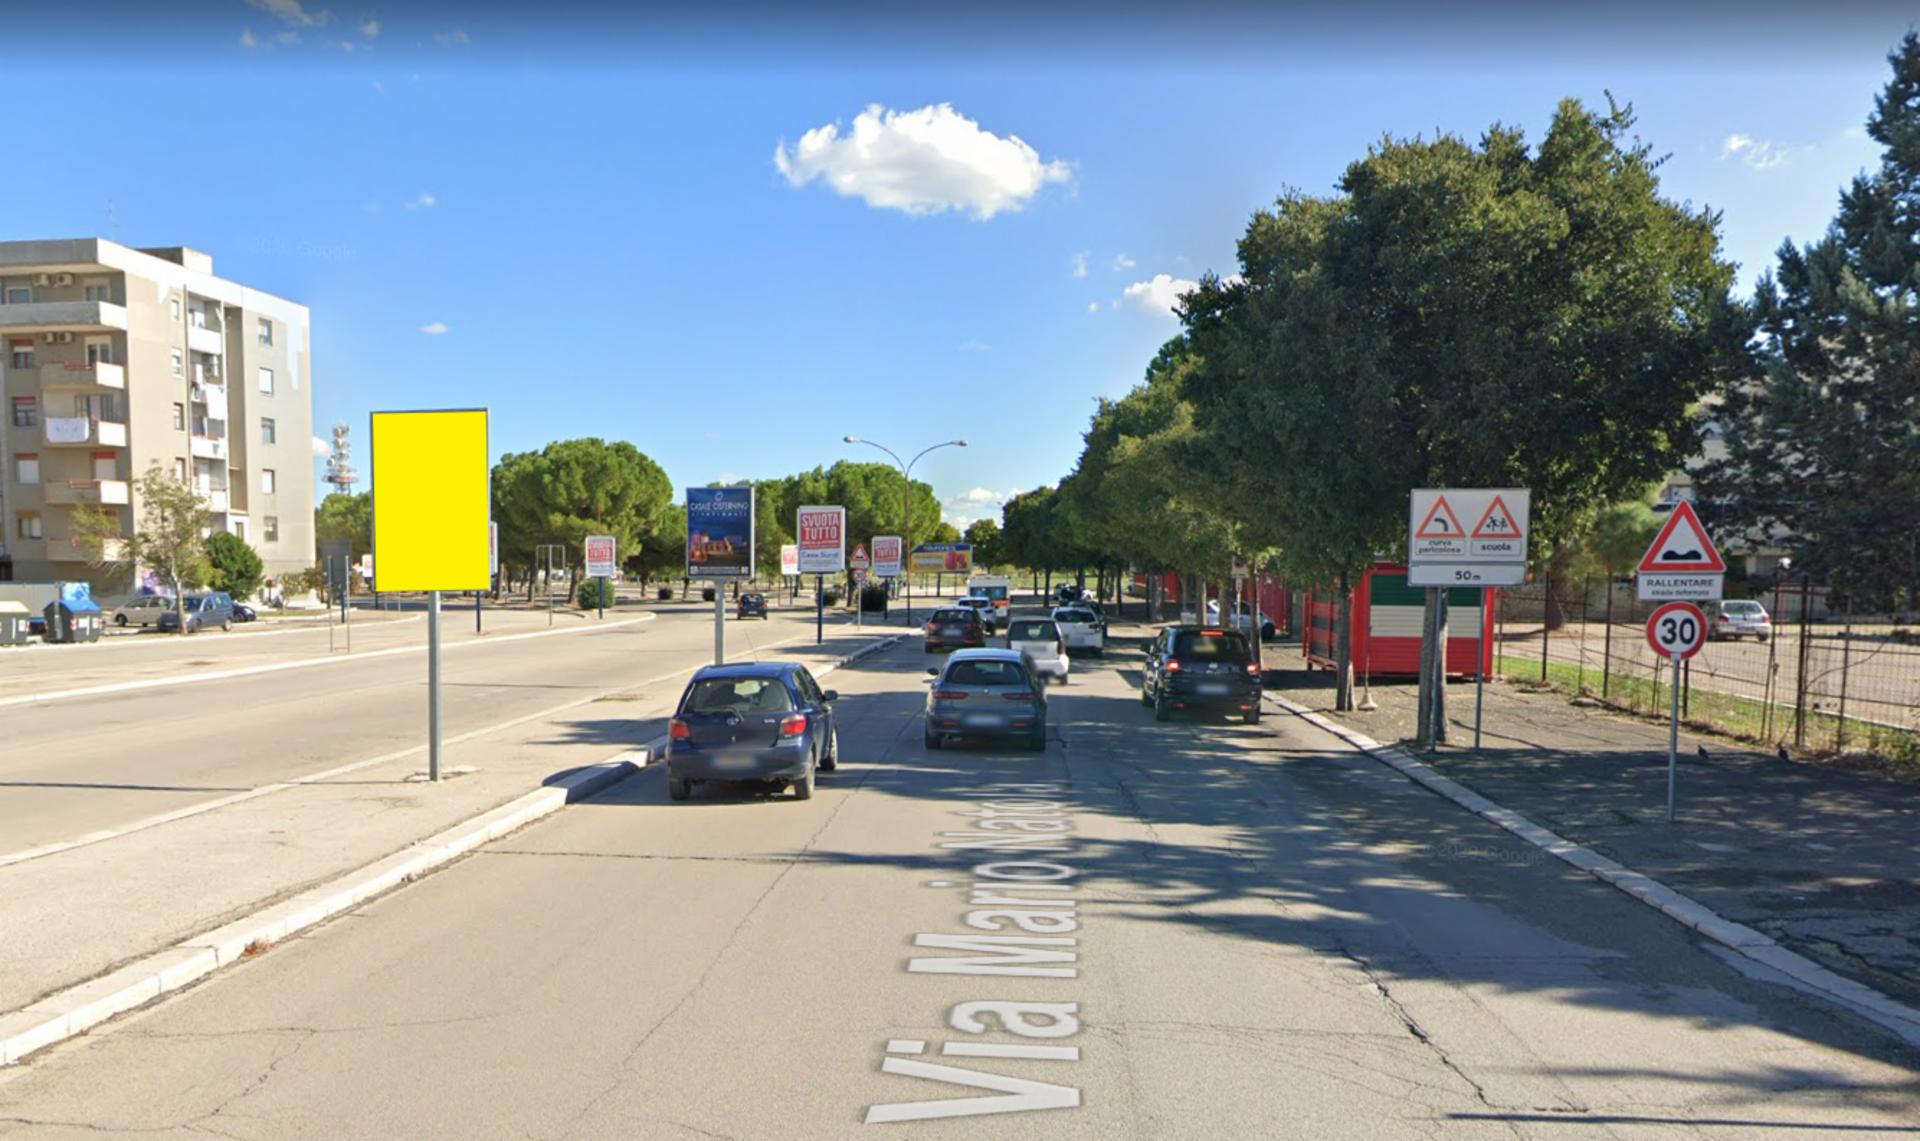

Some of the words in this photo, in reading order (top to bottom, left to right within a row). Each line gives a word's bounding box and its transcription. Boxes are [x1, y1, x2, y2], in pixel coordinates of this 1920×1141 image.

[802, 513, 839, 527] SVUOTA
[804, 526, 838, 540] TUTTO
[1481, 543, 1512, 551] scuola
[1455, 570, 1472, 580] 50
[1647, 579, 1713, 587] RALLENTARE
[1661, 617, 1696, 645] 30
